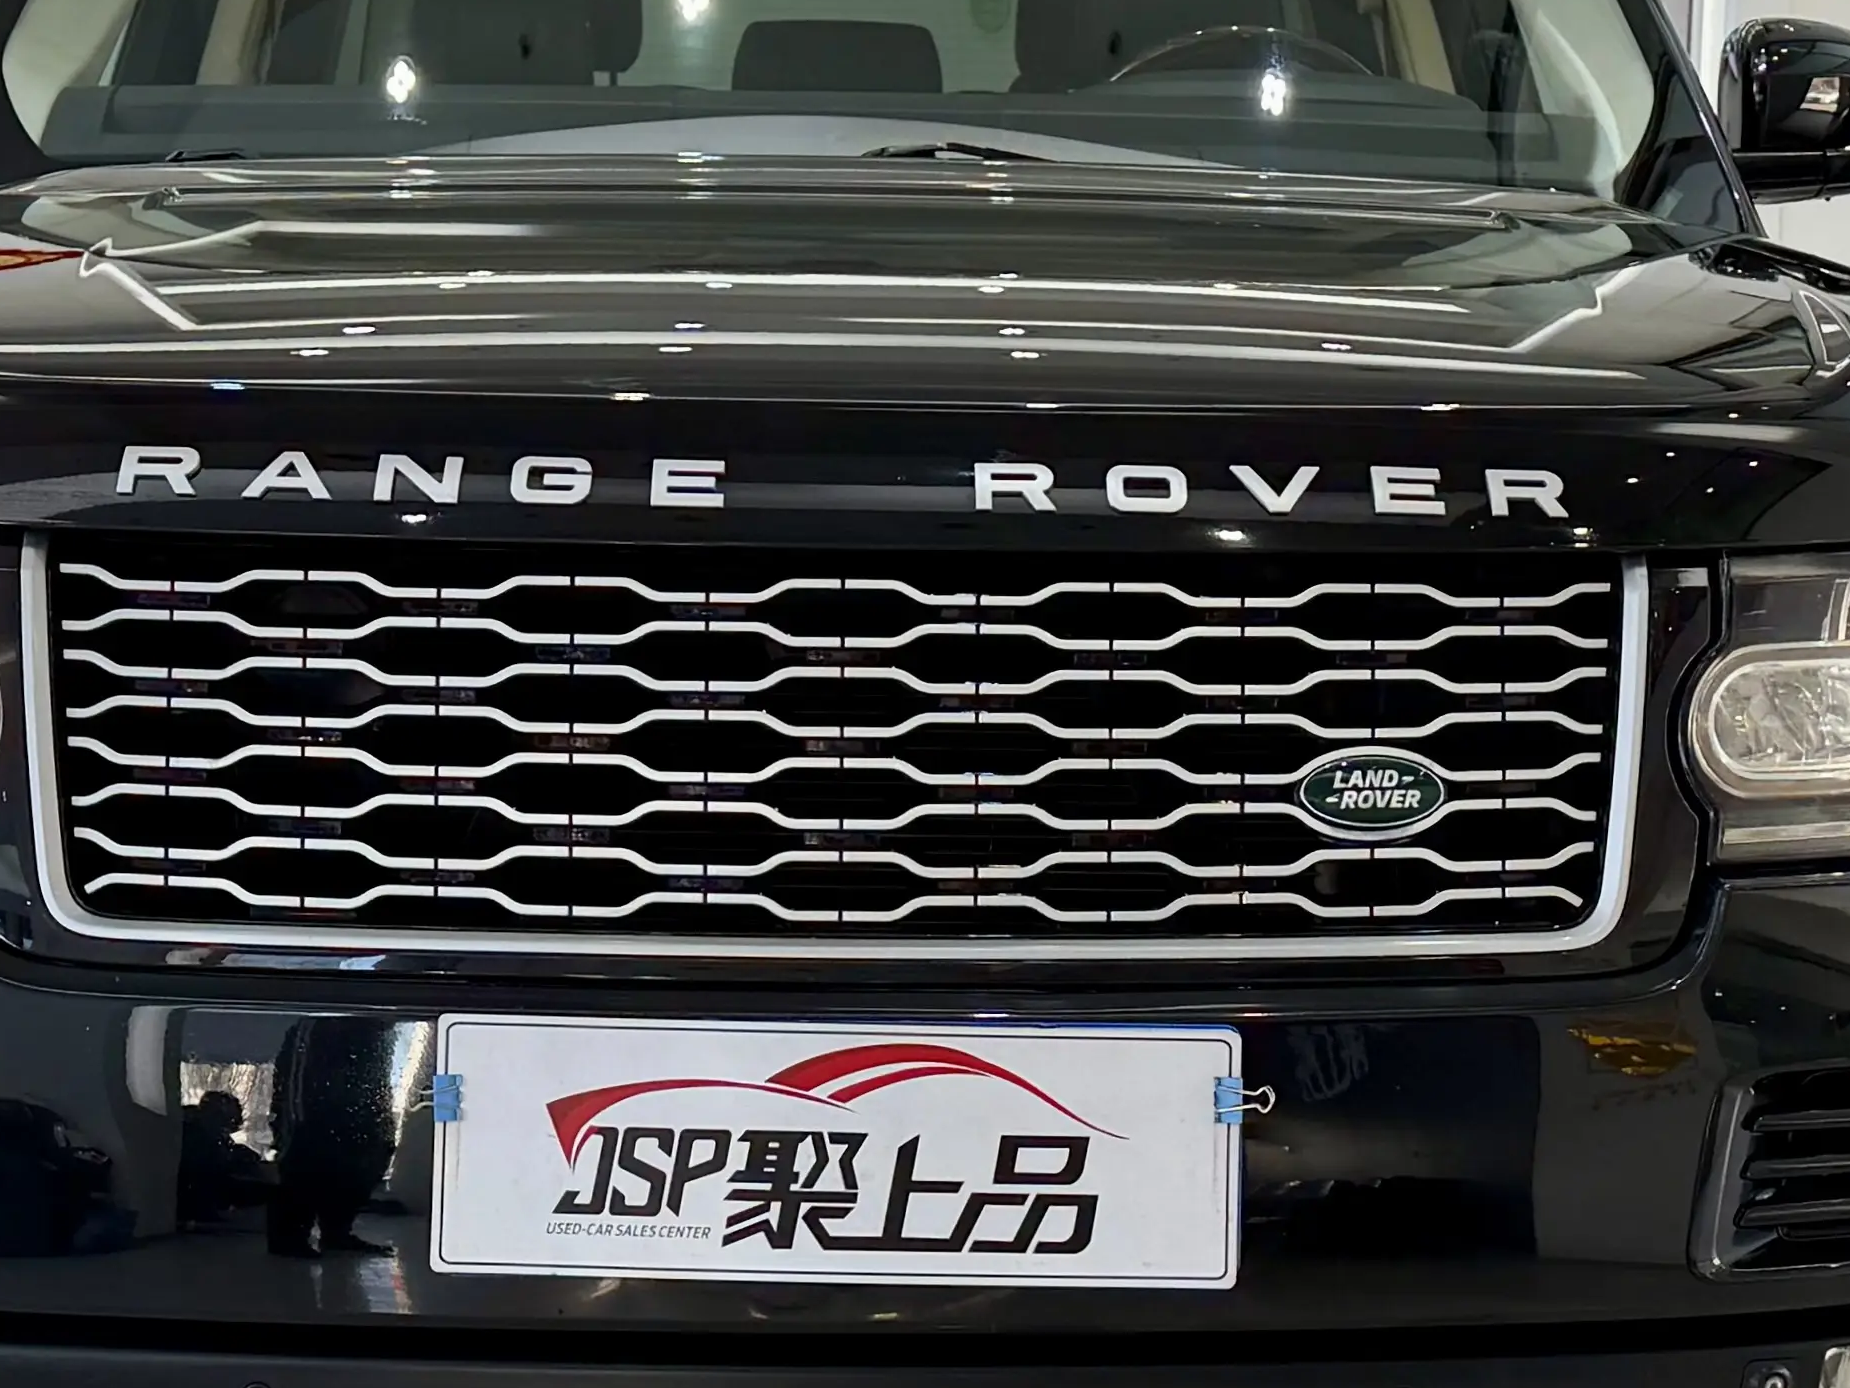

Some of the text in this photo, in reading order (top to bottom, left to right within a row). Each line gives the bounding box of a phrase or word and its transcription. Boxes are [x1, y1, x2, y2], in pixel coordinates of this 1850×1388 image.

[115, 443, 1570, 520] RANGE ROVER
[1333, 769, 1400, 789] LAND
[1339, 789, 1422, 810] ROVER
[545, 1221, 712, 1240] USED-CAR SALES CENTER
